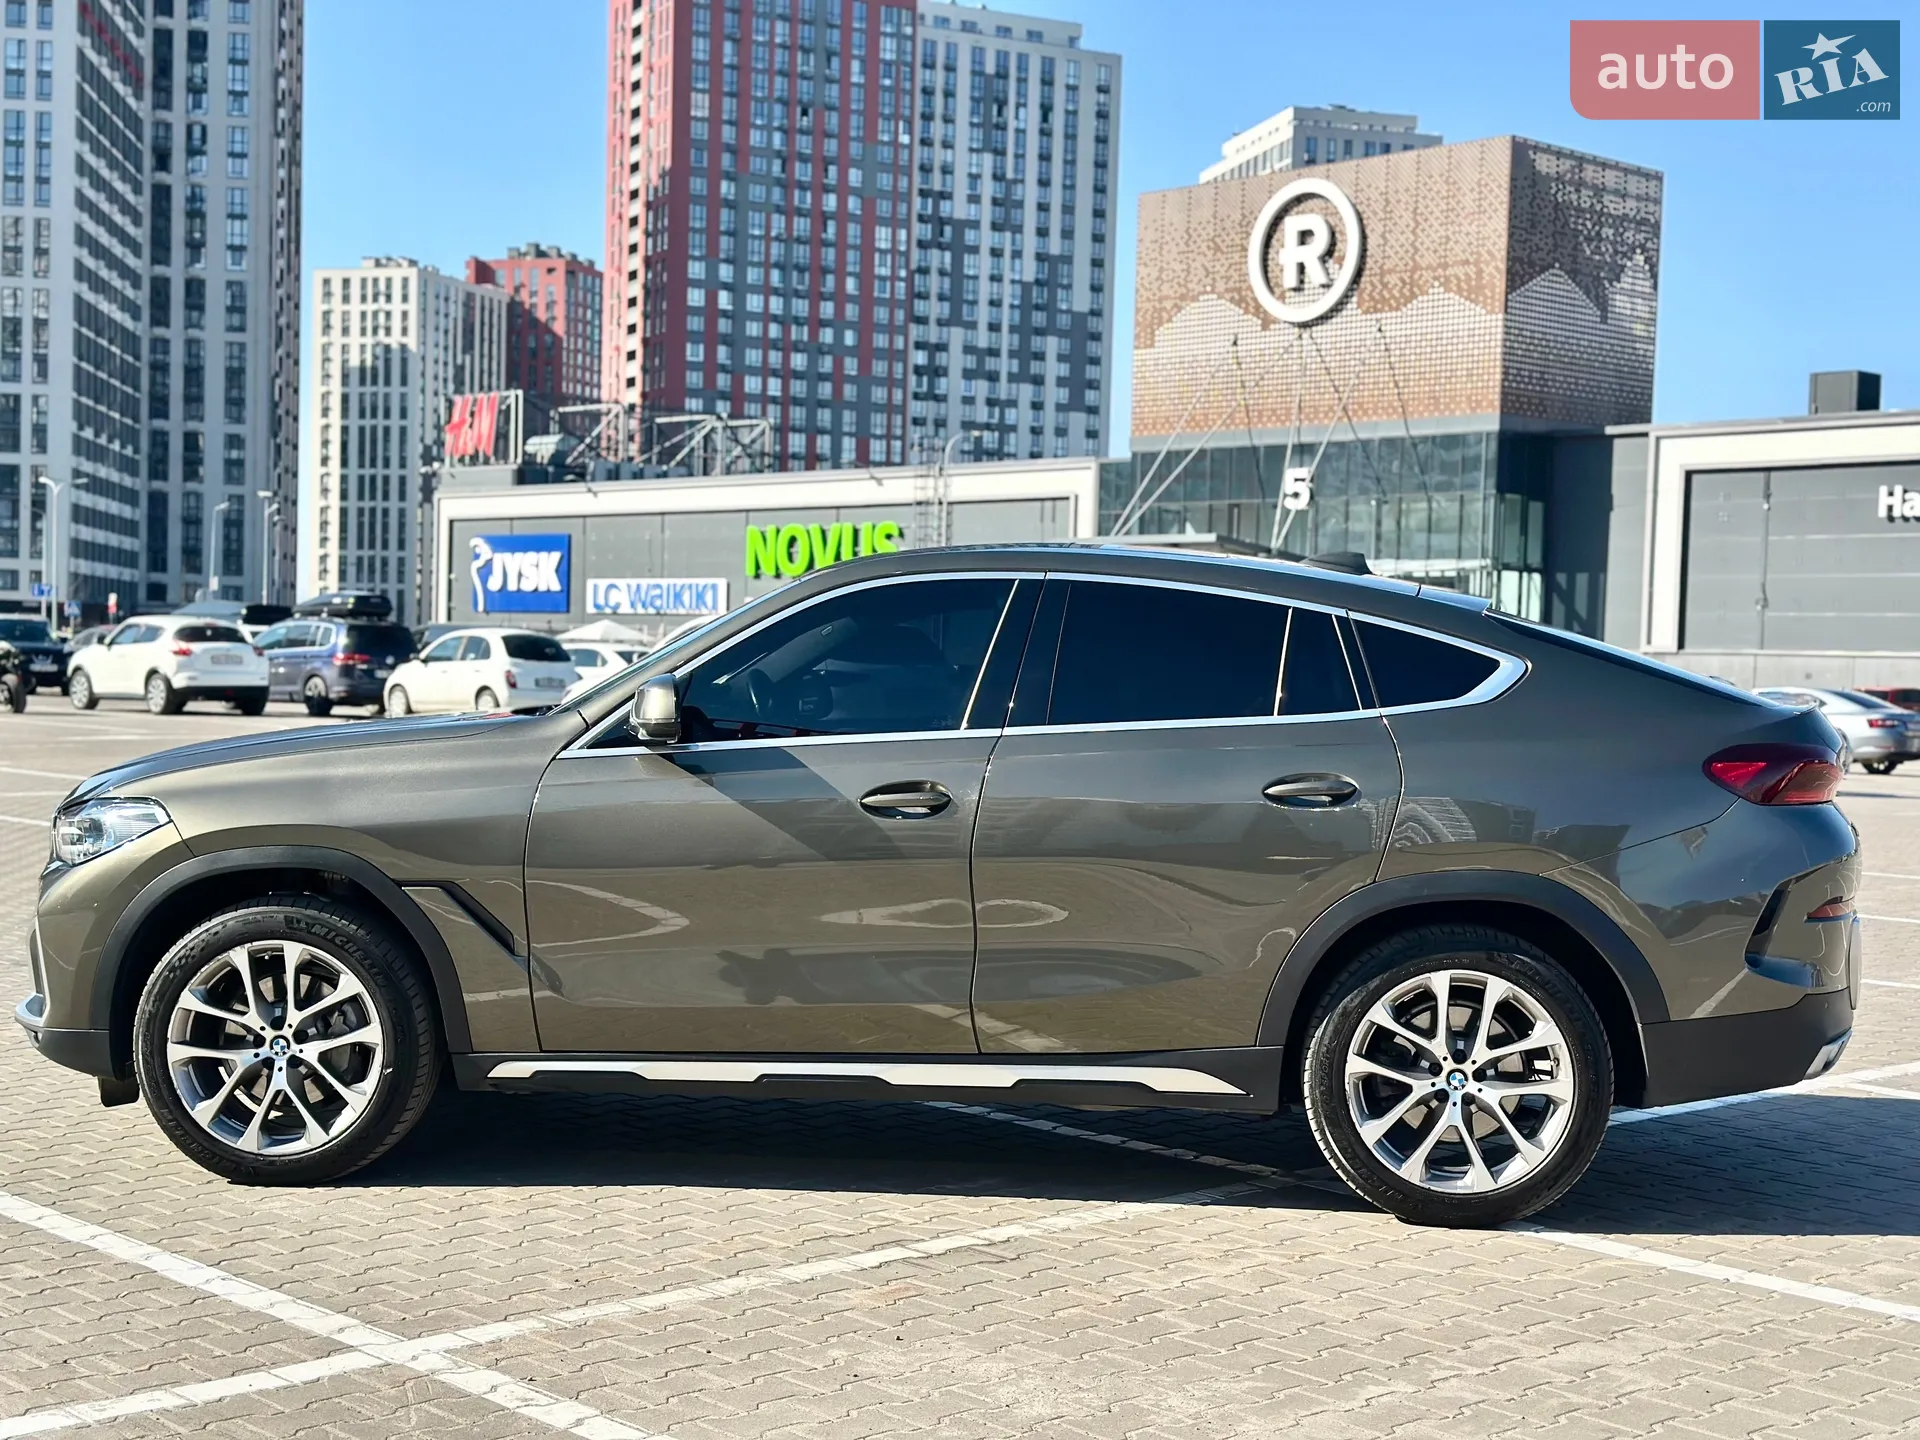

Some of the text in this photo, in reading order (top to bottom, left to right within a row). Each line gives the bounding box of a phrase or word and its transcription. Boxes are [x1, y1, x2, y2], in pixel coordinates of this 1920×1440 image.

[445, 391, 500, 457] H&M
[1284, 467, 1311, 510] 5
[745, 520, 900, 577] NOVUS
[487, 551, 563, 592] JYSK
[593, 583, 621, 611] LC
